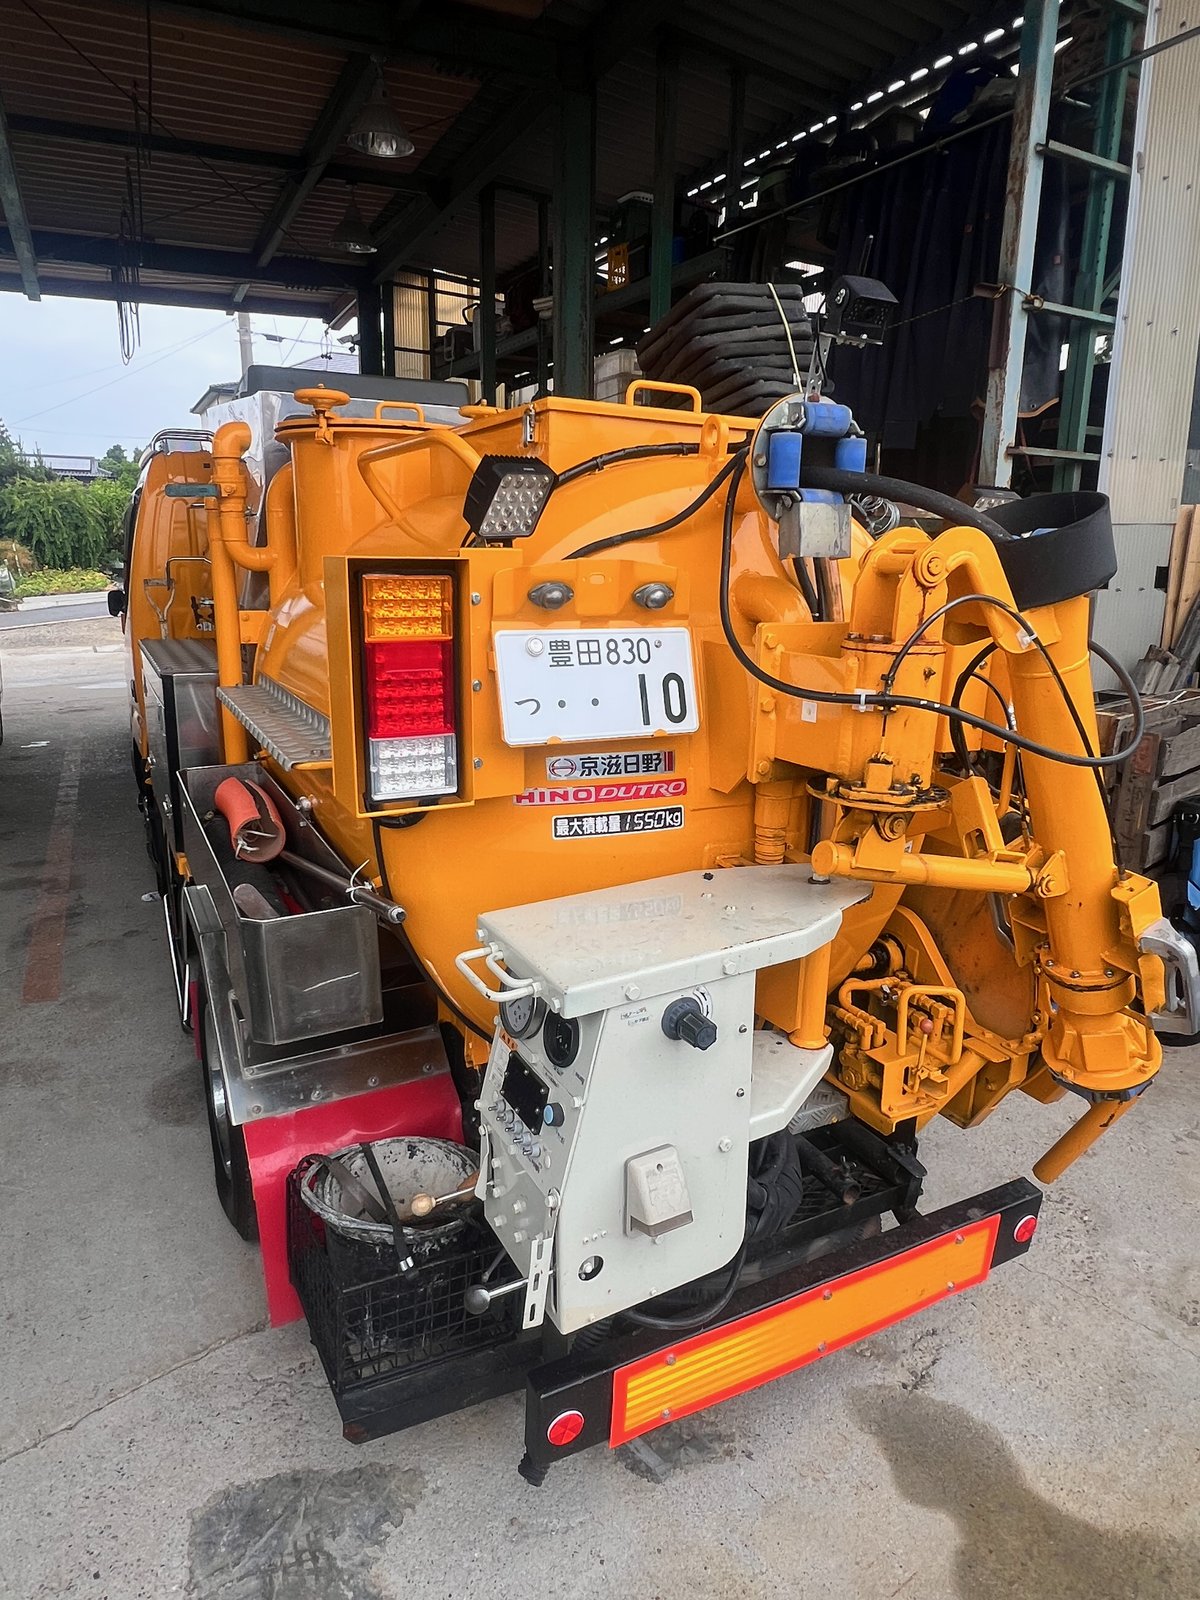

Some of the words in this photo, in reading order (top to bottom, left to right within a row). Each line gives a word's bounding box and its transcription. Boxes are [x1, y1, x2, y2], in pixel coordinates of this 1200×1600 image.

[514, 698, 541, 715] つ
[579, 752, 662, 777] 京滋日野
[516, 788, 594, 804] HINO
[598, 780, 686, 799] DUTRO
